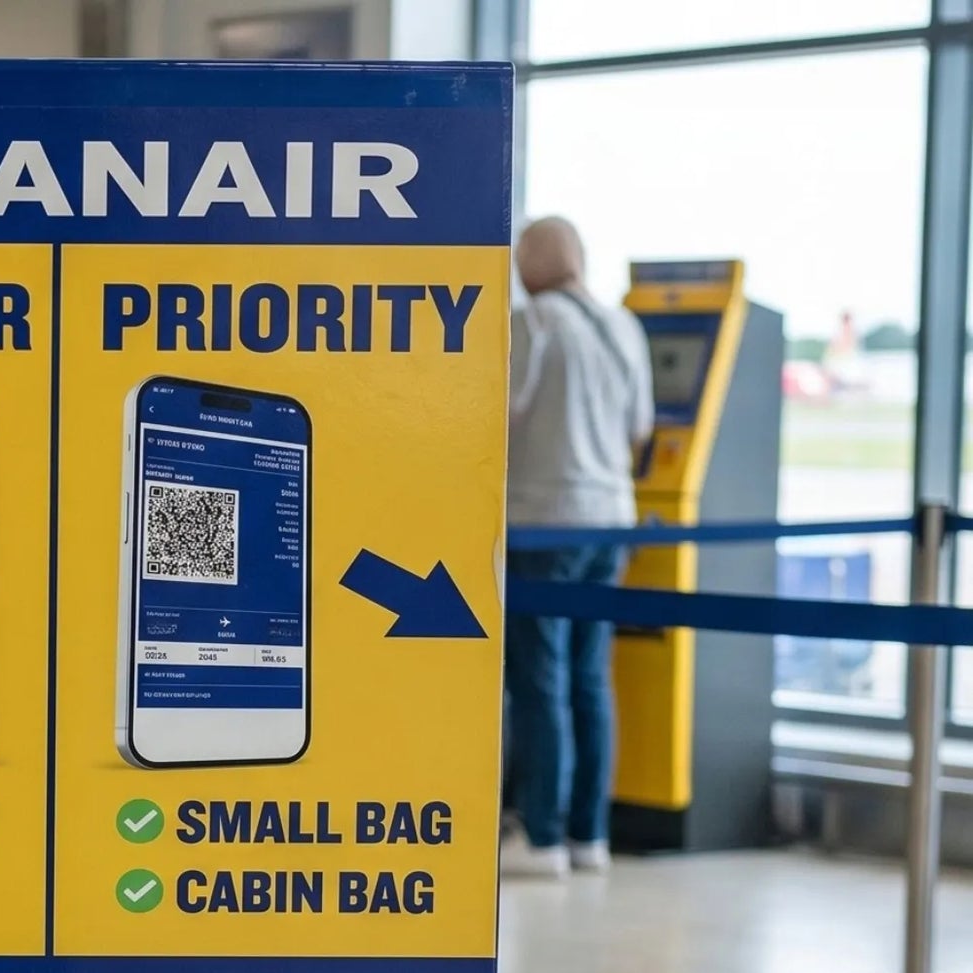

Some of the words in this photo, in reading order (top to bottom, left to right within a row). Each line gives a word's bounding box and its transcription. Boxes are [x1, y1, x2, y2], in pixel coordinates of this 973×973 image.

[102, 282, 483, 354] PRIORITY
[176, 800, 343, 844] SMALL
[355, 801, 452, 845] BAG
[176, 869, 324, 914] CABIN
[338, 870, 434, 915] BAG
